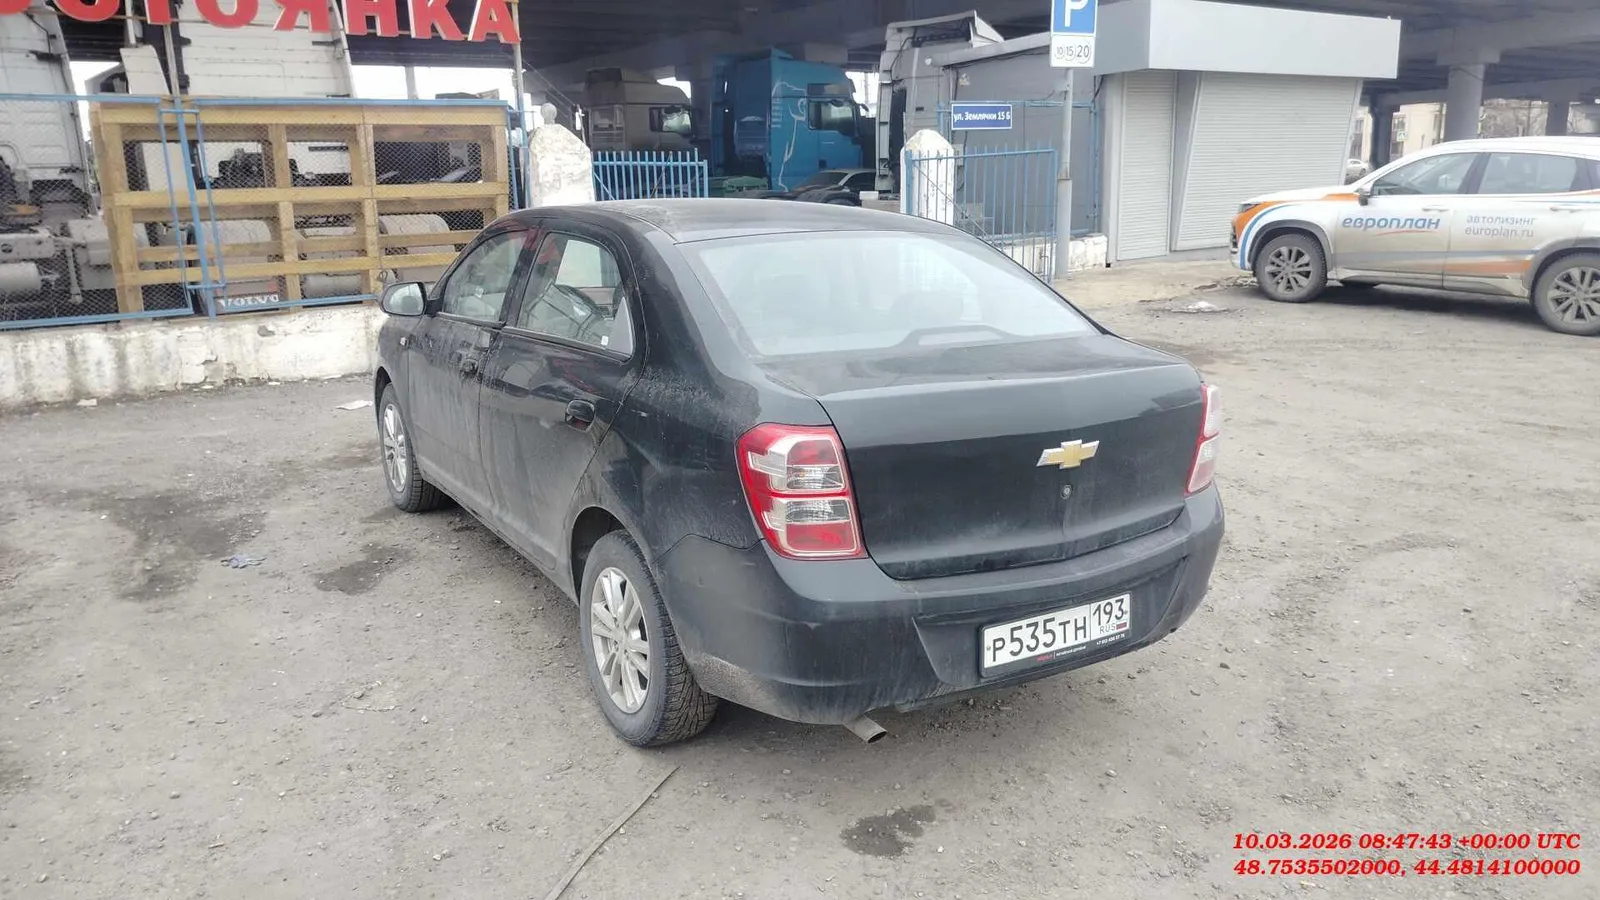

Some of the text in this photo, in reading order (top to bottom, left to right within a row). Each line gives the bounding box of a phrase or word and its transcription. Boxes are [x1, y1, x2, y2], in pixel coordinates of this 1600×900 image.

[1066, 46, 1074, 57] 15
[1077, 45, 1090, 58] 20
[953, 113, 964, 122] ул.
[965, 111, 997, 121] Землячки
[998, 111, 1005, 120] 15
[1342, 216, 1441, 231] европлан
[1466, 214, 1537, 226] автолизинг
[1464, 226, 1535, 240] europlan.ru
[218, 294, 279, 308] VOLVO
[1093, 598, 1125, 626] 193
[1100, 622, 1116, 635] RUS
